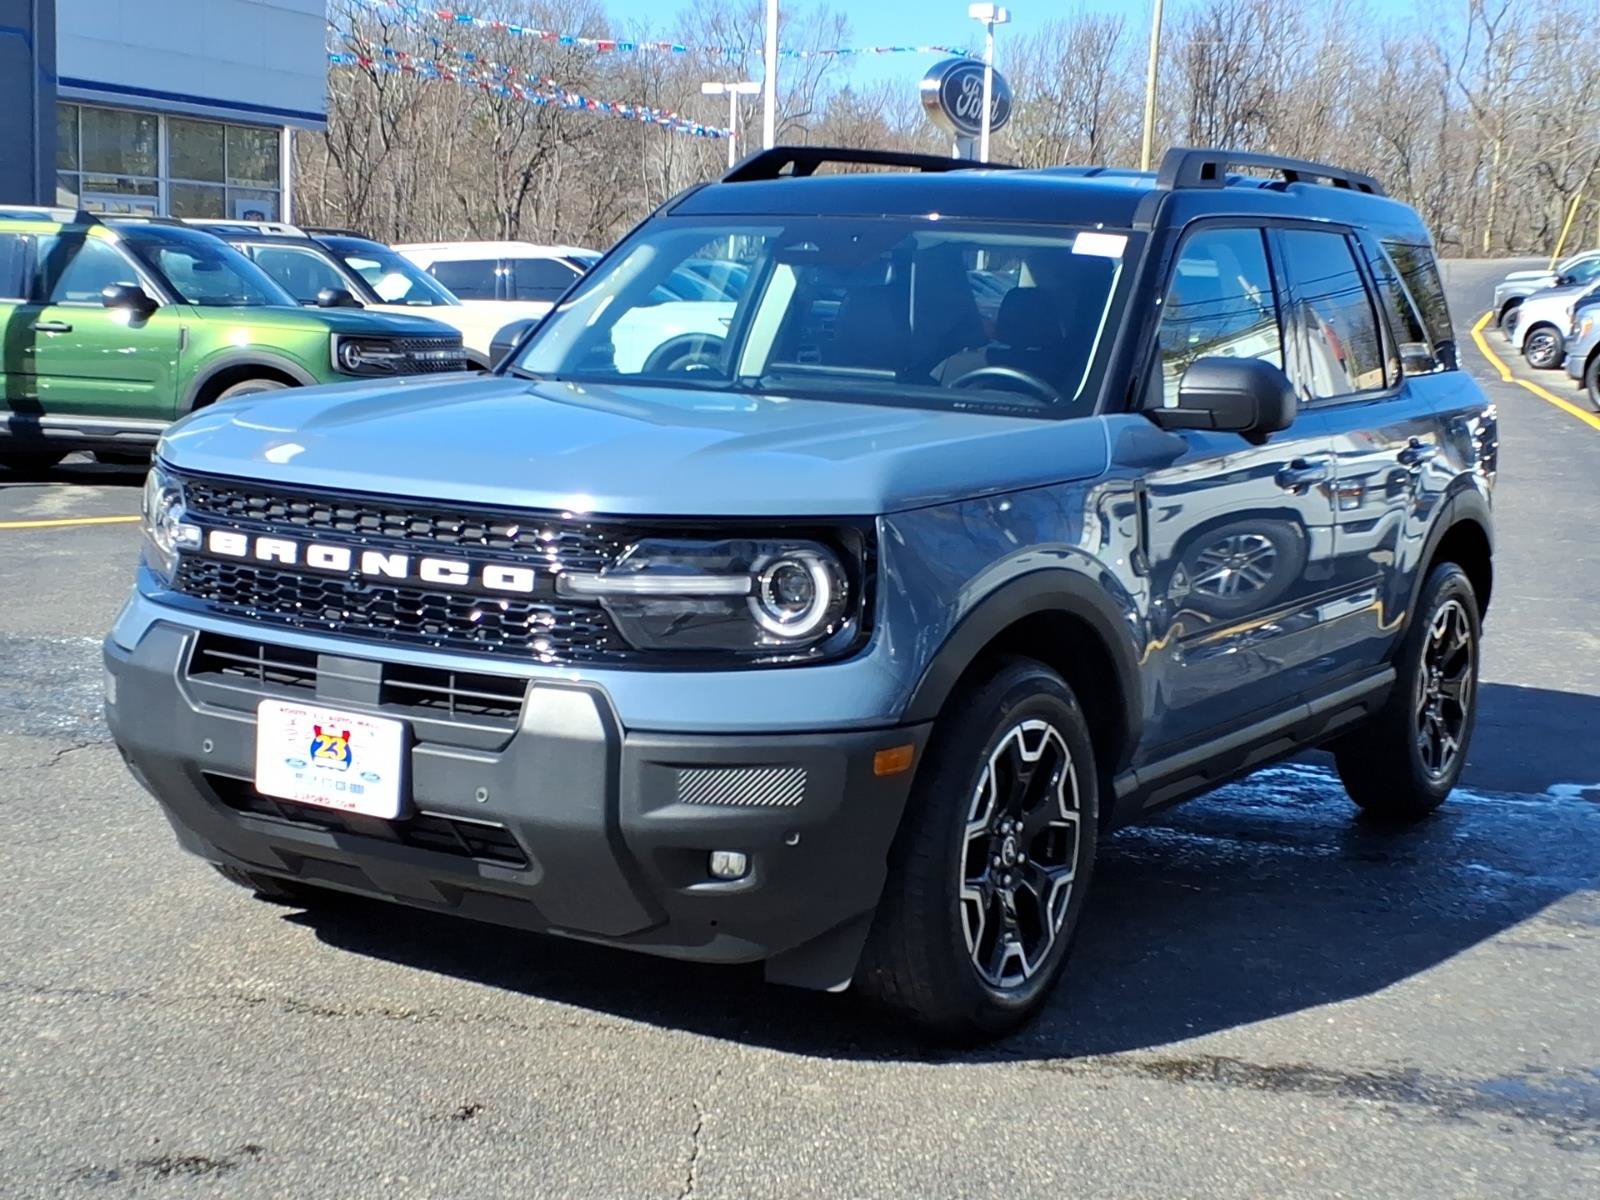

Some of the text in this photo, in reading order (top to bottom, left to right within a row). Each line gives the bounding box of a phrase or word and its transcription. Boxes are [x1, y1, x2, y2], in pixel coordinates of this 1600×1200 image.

[956, 74, 1001, 122] Fod
[209, 530, 535, 593] BRONCO
[314, 734, 347, 762] 23
